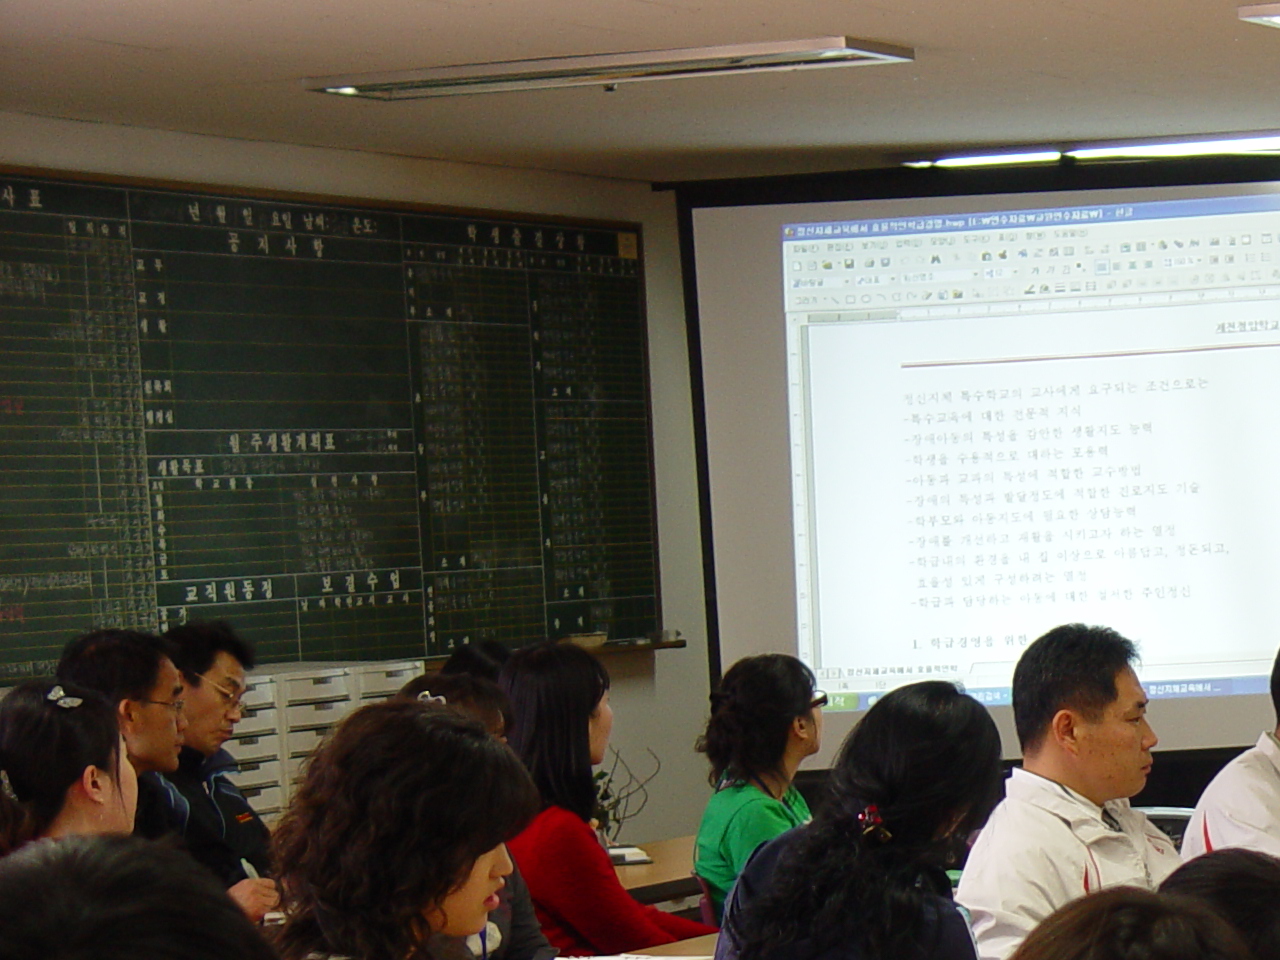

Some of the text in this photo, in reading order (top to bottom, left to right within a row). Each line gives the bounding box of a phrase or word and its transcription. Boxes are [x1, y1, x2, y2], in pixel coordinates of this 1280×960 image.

[961, 388, 1021, 402] 특수학교의
[1032, 384, 1080, 398] 교사에게
[1089, 381, 1137, 395] 요구되는
[1146, 377, 1208, 392] 조건으로는
[982, 409, 1004, 422] 대한
[1015, 407, 1048, 421] 전문적
[1058, 404, 1081, 417] 지식
[983, 430, 1017, 443] 특성을
[1072, 424, 1121, 438] 생활지도
[1130, 421, 1152, 434] 능력
[958, 450, 1019, 464] 수용적으로
[1028, 448, 1063, 461] 대하는
[1072, 445, 1108, 459] 포용력
[1004, 469, 1038, 483] 특성에
[1049, 467, 1083, 480] 적합한
[1093, 464, 1141, 478] 교수방법
[1005, 488, 1064, 503] 발달정도에
[1119, 484, 1167, 498] 진로지도
[973, 511, 1034, 525] 아동지도에
[1087, 505, 1136, 520] 상담능력
[1064, 527, 1112, 541] 시키고자
[1120, 525, 1144, 539] 하는
[1152, 524, 1176, 538] 열정
[1019, 551, 1030, 564] 내
[1057, 548, 1106, 562] 이상으로
[185, 578, 273, 603] 교직원동정
[321, 569, 400, 594] 보결수업
[962, 574, 985, 587] 있게
[994, 571, 1055, 586] 구성하려는
[1142, 585, 1191, 600] 주인정신
[1149, 682, 1211, 696] 정신지체교육에서
